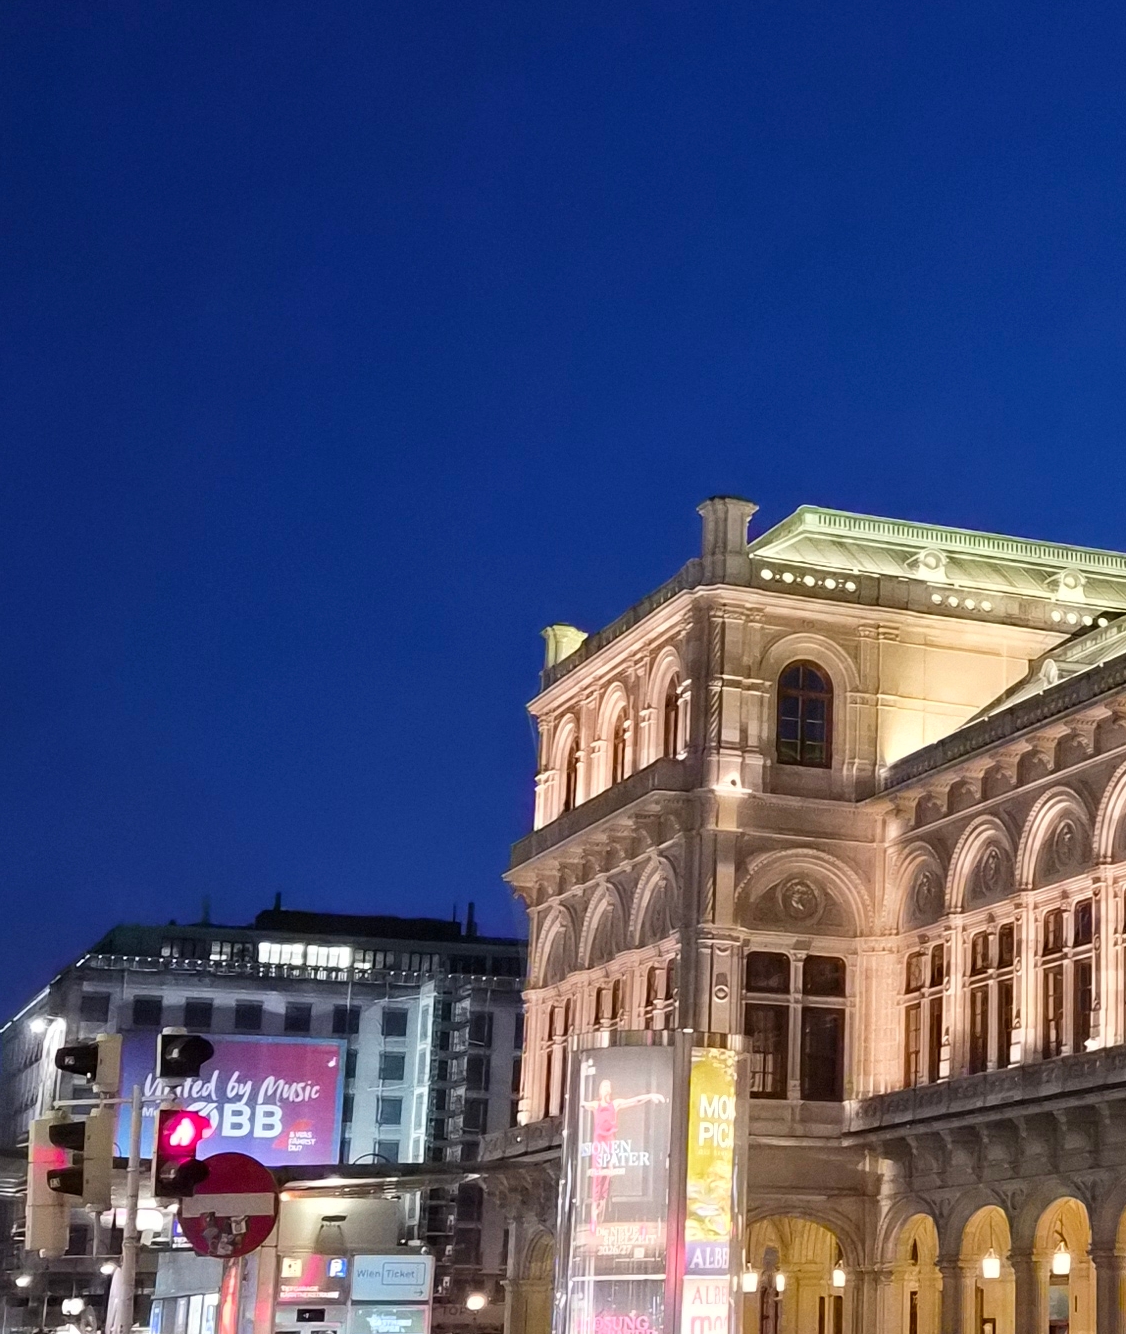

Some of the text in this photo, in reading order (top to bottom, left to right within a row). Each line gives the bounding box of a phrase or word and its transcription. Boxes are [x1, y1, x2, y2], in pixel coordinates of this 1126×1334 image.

[143, 1070, 320, 1105] Uted by Music
[357, 1269, 415, 1278] Wien Ticket
